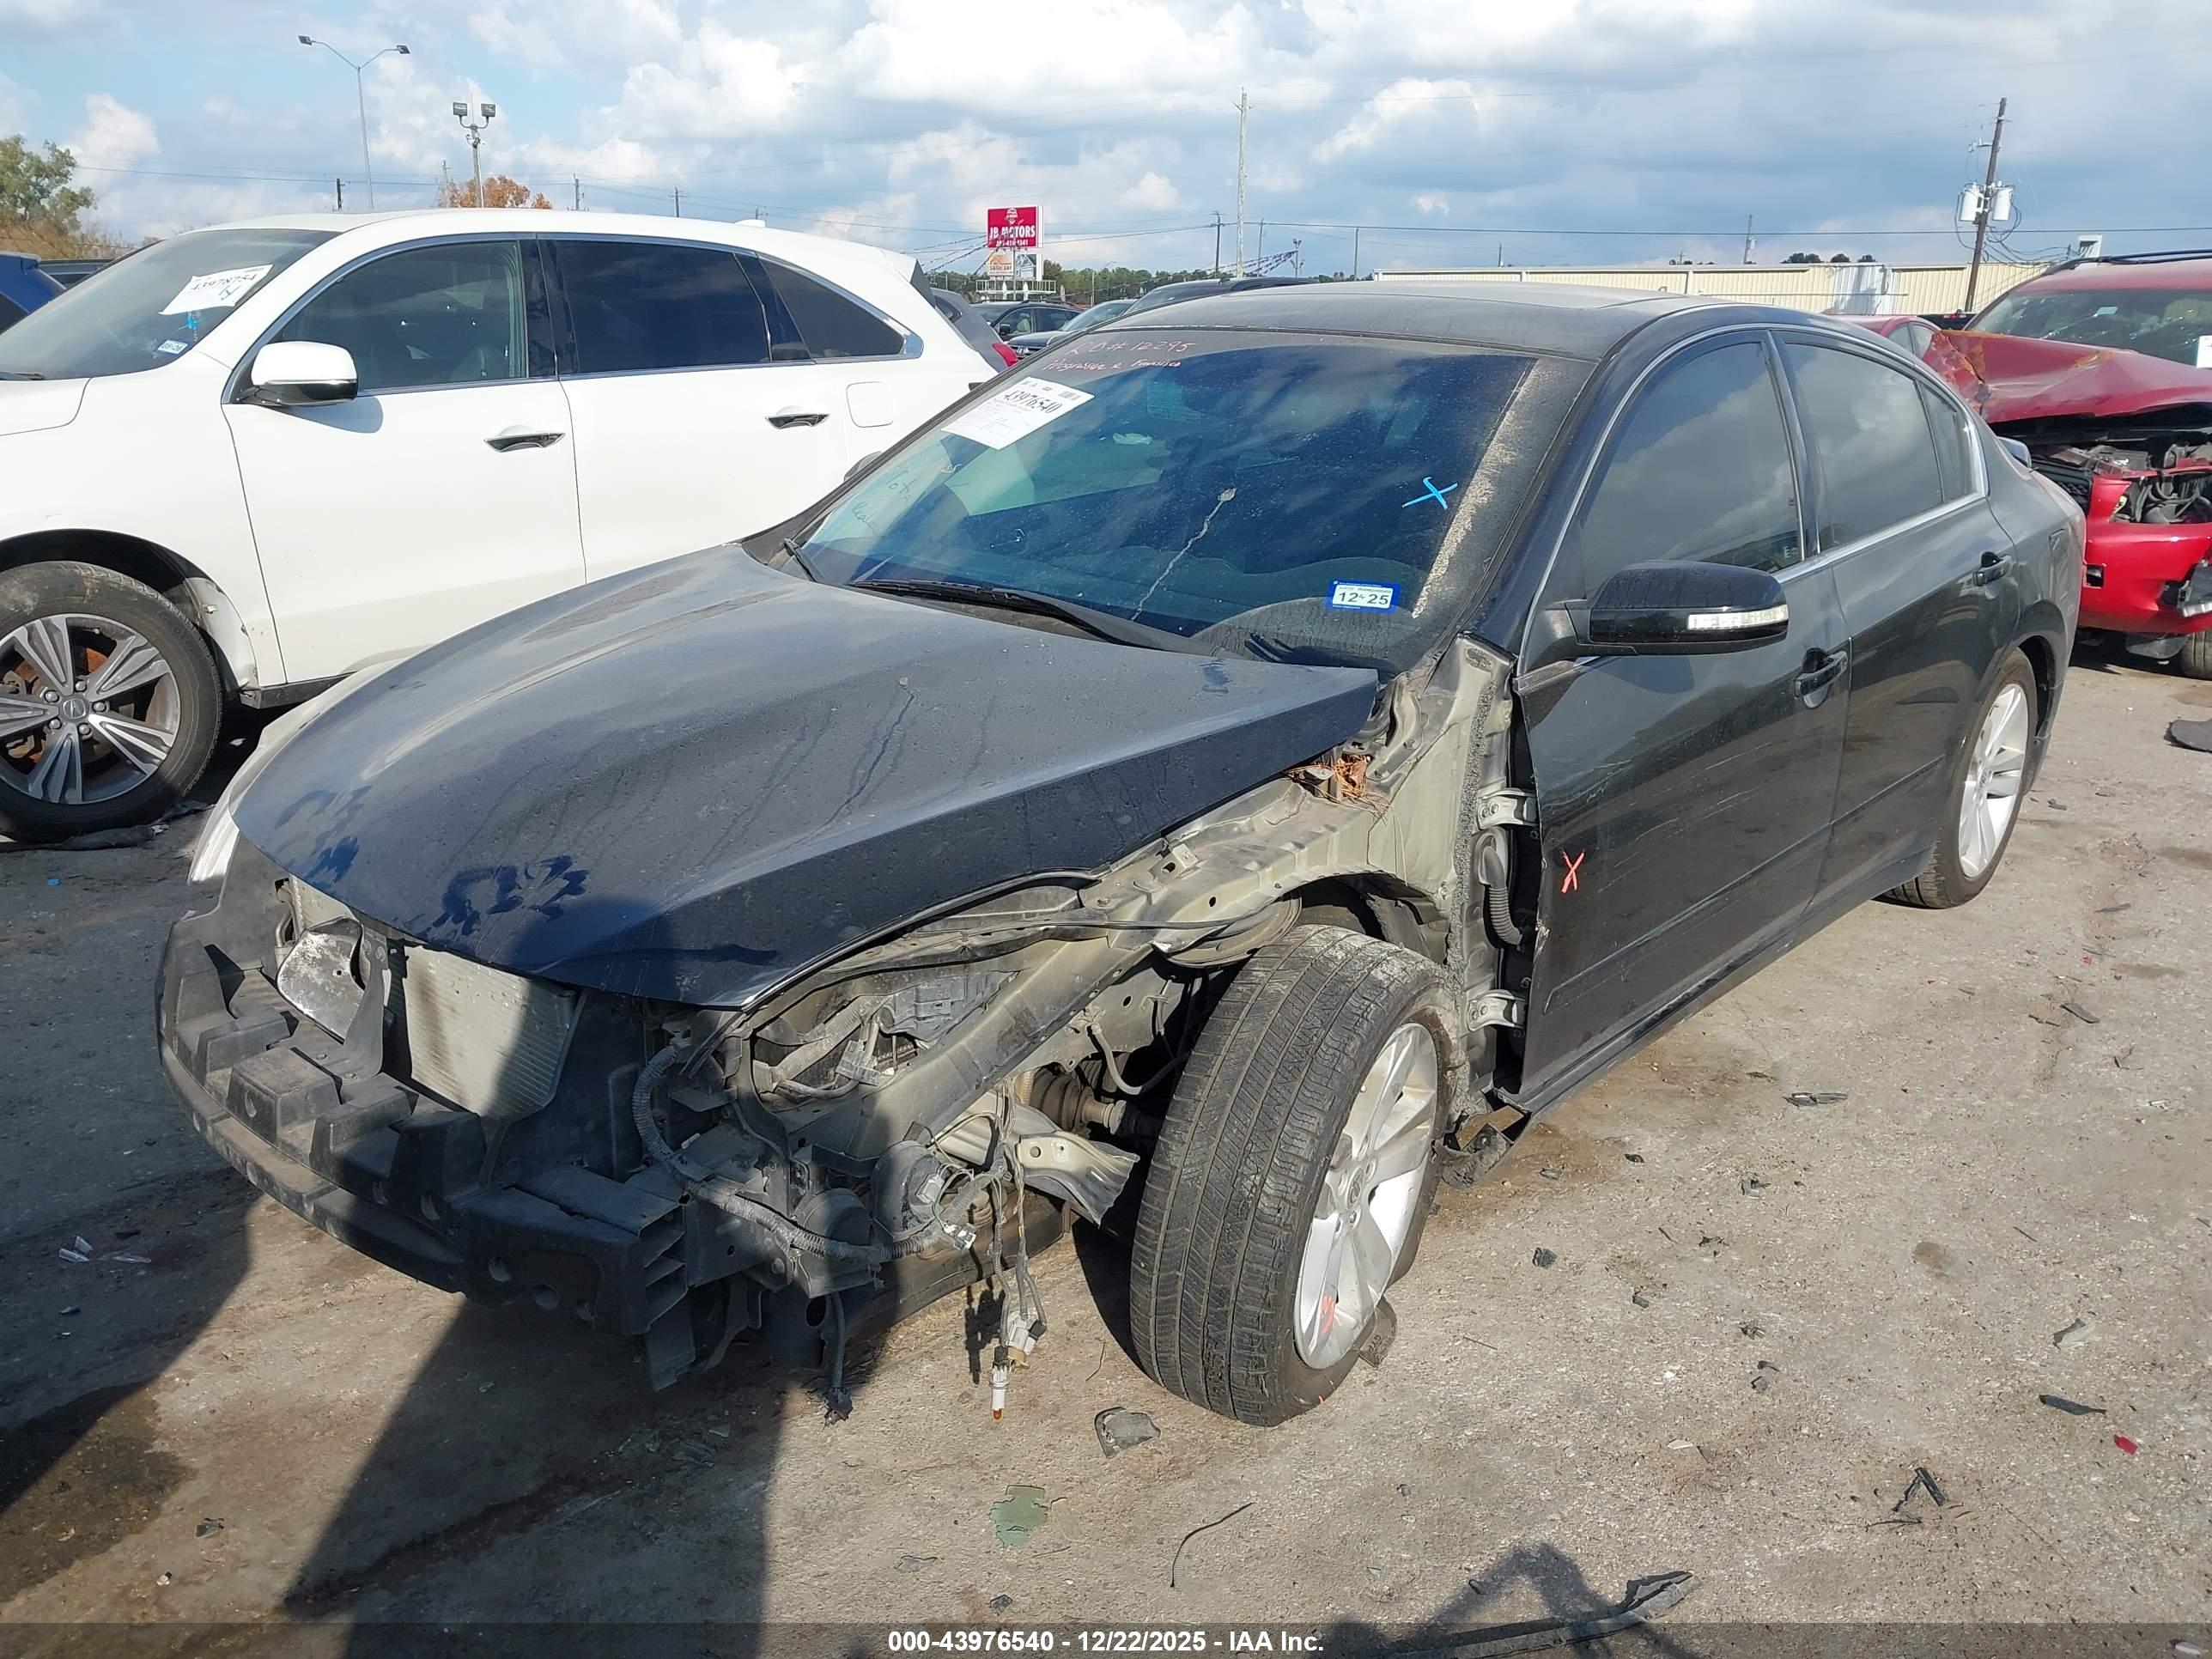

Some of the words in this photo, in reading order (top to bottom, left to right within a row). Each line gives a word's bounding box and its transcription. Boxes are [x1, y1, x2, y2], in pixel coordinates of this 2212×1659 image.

[989, 227, 1000, 240] JB
[1001, 225, 1036, 238] MOTORS
[1003, 390, 1063, 414] 43976540
